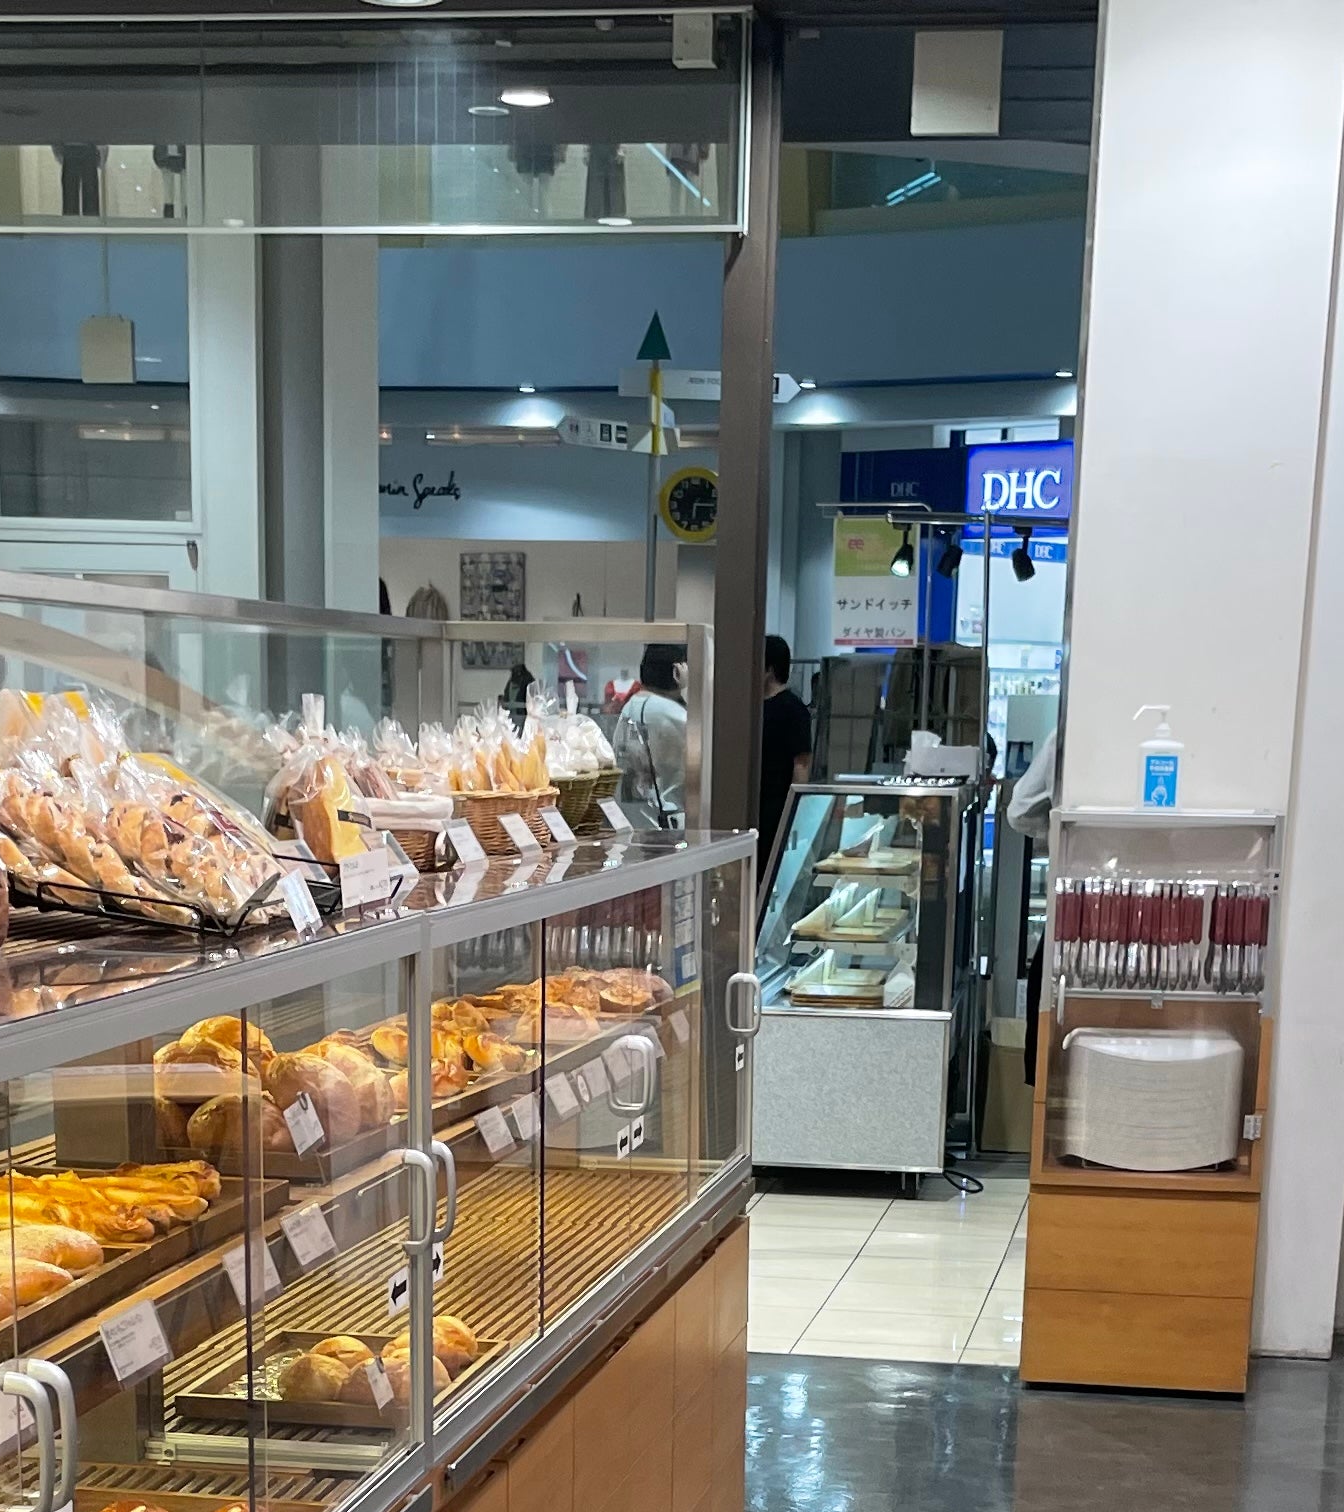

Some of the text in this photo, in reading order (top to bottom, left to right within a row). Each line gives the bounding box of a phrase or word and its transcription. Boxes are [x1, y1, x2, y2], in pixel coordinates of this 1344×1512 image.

[890, 482, 920, 498] DHC
[981, 469, 1061, 511] DHC
[837, 598, 912, 611] サンドイッチ
